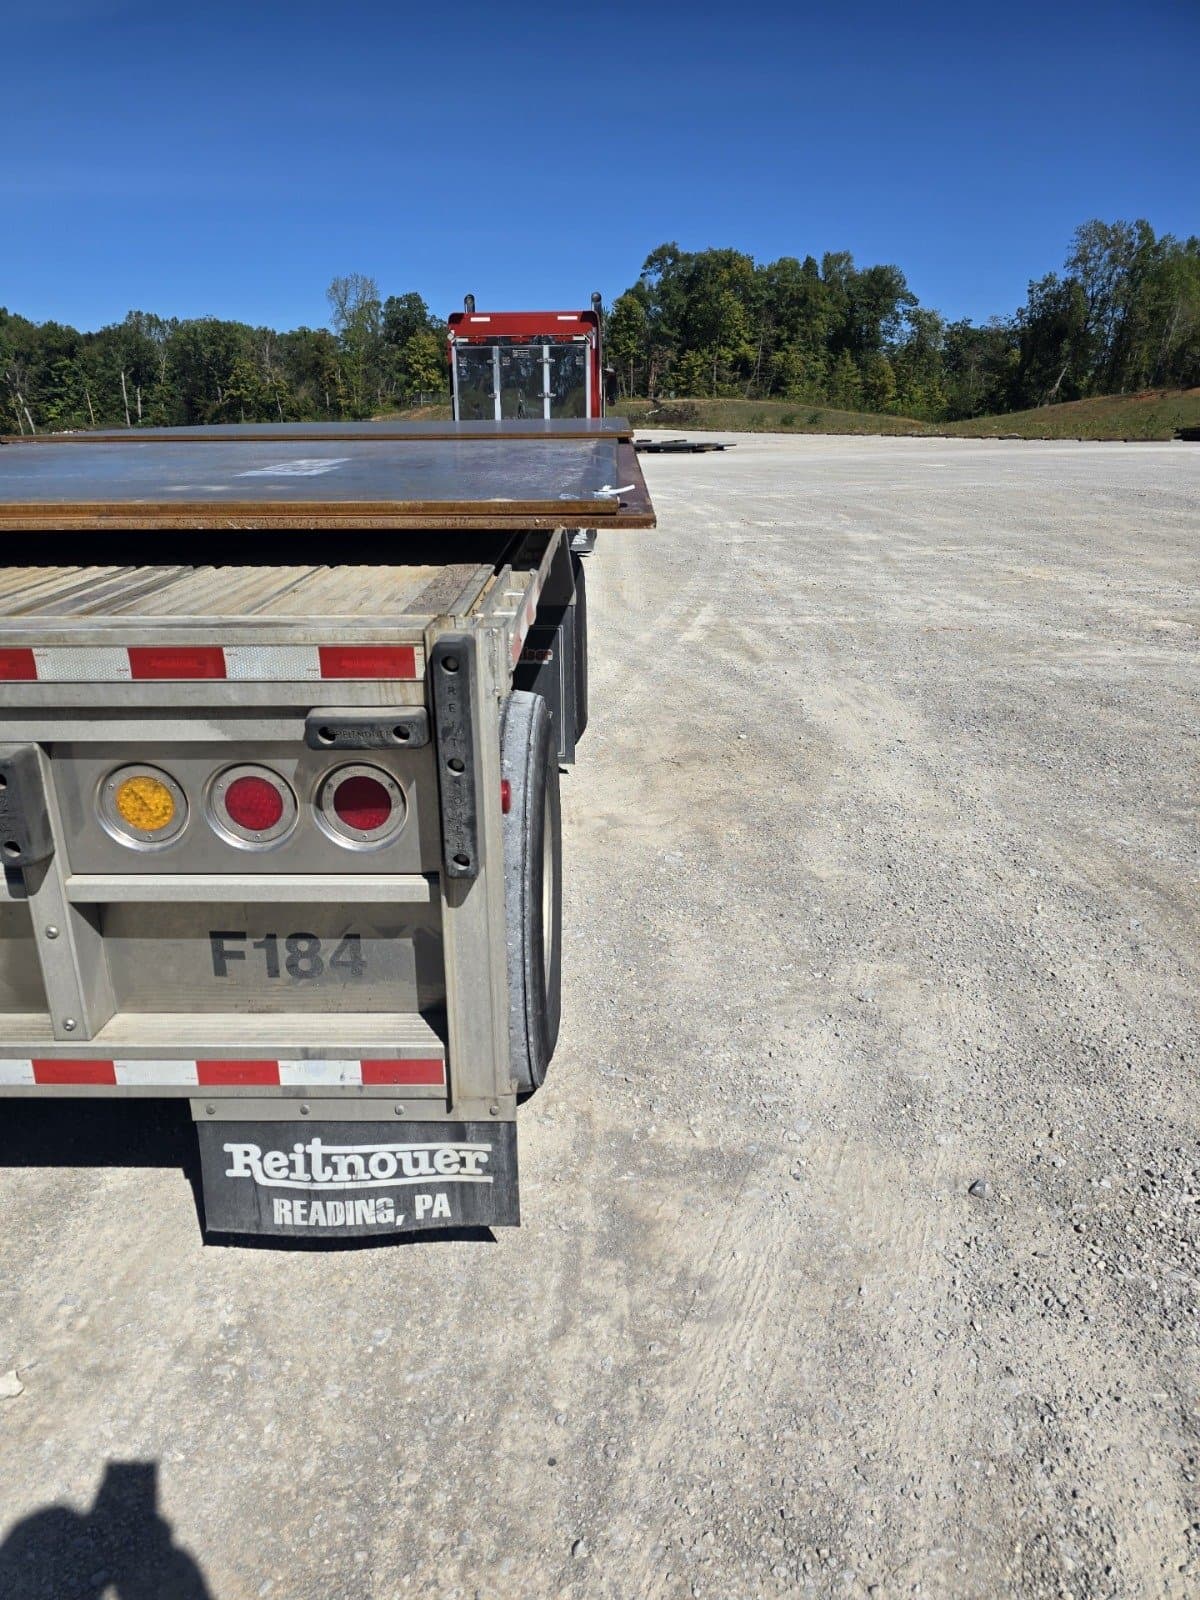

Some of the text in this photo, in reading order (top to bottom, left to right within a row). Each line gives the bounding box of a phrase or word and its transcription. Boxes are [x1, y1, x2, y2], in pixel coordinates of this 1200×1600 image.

[208, 930, 368, 979] F184
[223, 1137, 490, 1183] Reitnouer
[273, 1192, 452, 1227] READING, PA
